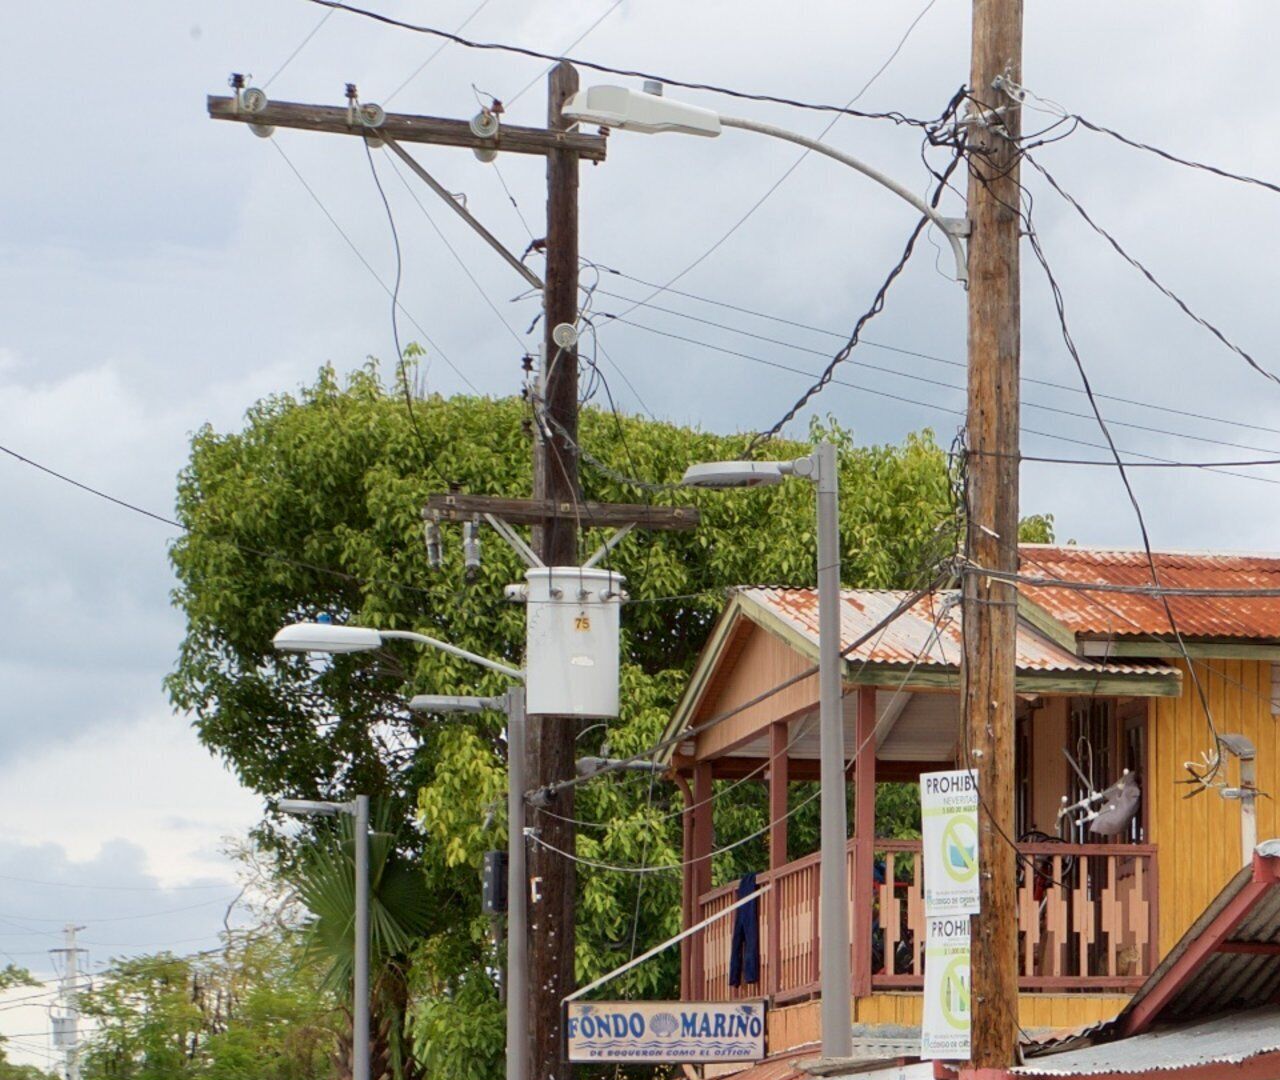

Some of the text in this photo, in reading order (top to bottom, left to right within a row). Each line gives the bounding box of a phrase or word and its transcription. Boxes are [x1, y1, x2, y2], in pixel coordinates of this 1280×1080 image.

[575, 618, 590, 629] 75
[569, 1012, 763, 1038] FONDO MARINO
[590, 1049, 603, 1057] DE
[607, 1048, 664, 1057] BOQUERON
[666, 1048, 696, 1057] COMO
[700, 1048, 711, 1057] EL
